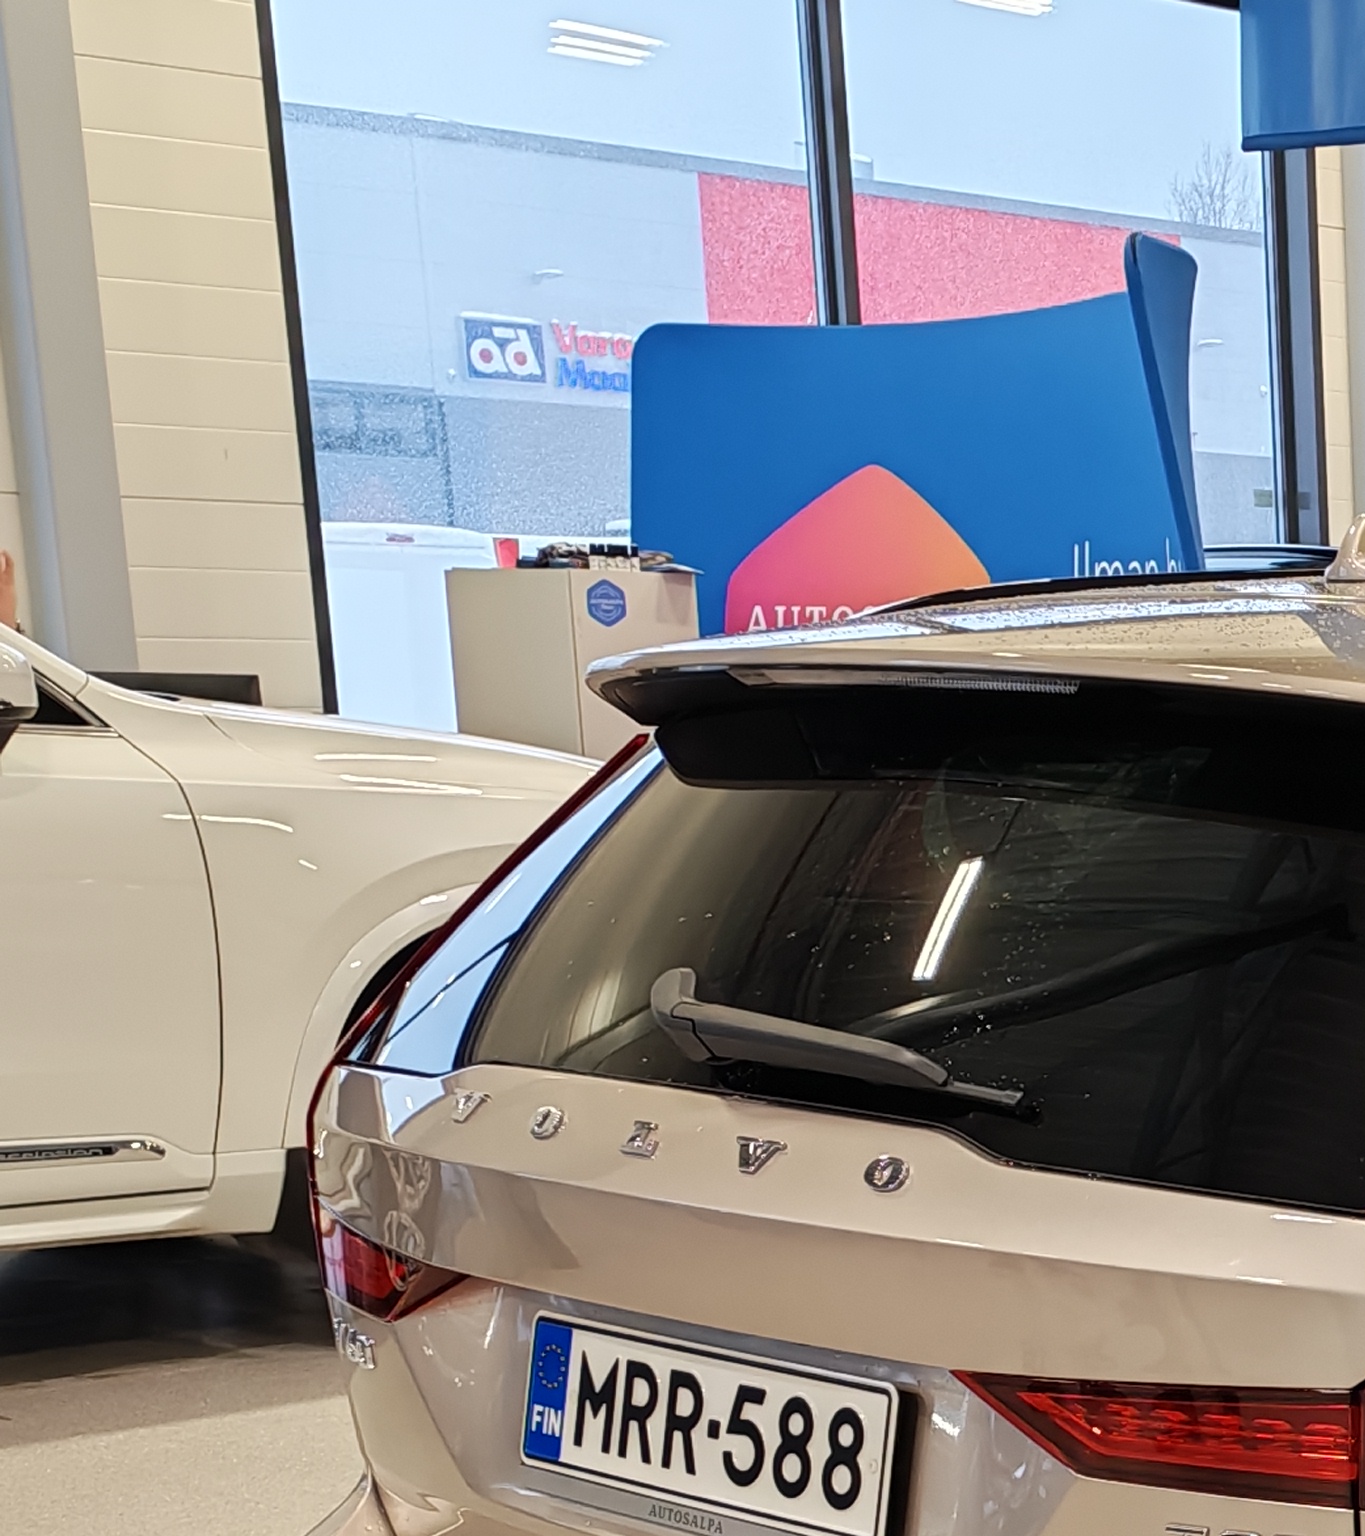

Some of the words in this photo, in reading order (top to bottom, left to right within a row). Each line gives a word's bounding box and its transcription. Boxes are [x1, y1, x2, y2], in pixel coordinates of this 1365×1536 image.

[451, 1086, 911, 1193] VOLVO
[531, 1404, 563, 1437] FIN
[573, 1349, 864, 1510] MRR-588
[648, 1503, 724, 1535] AUTOSALPA
